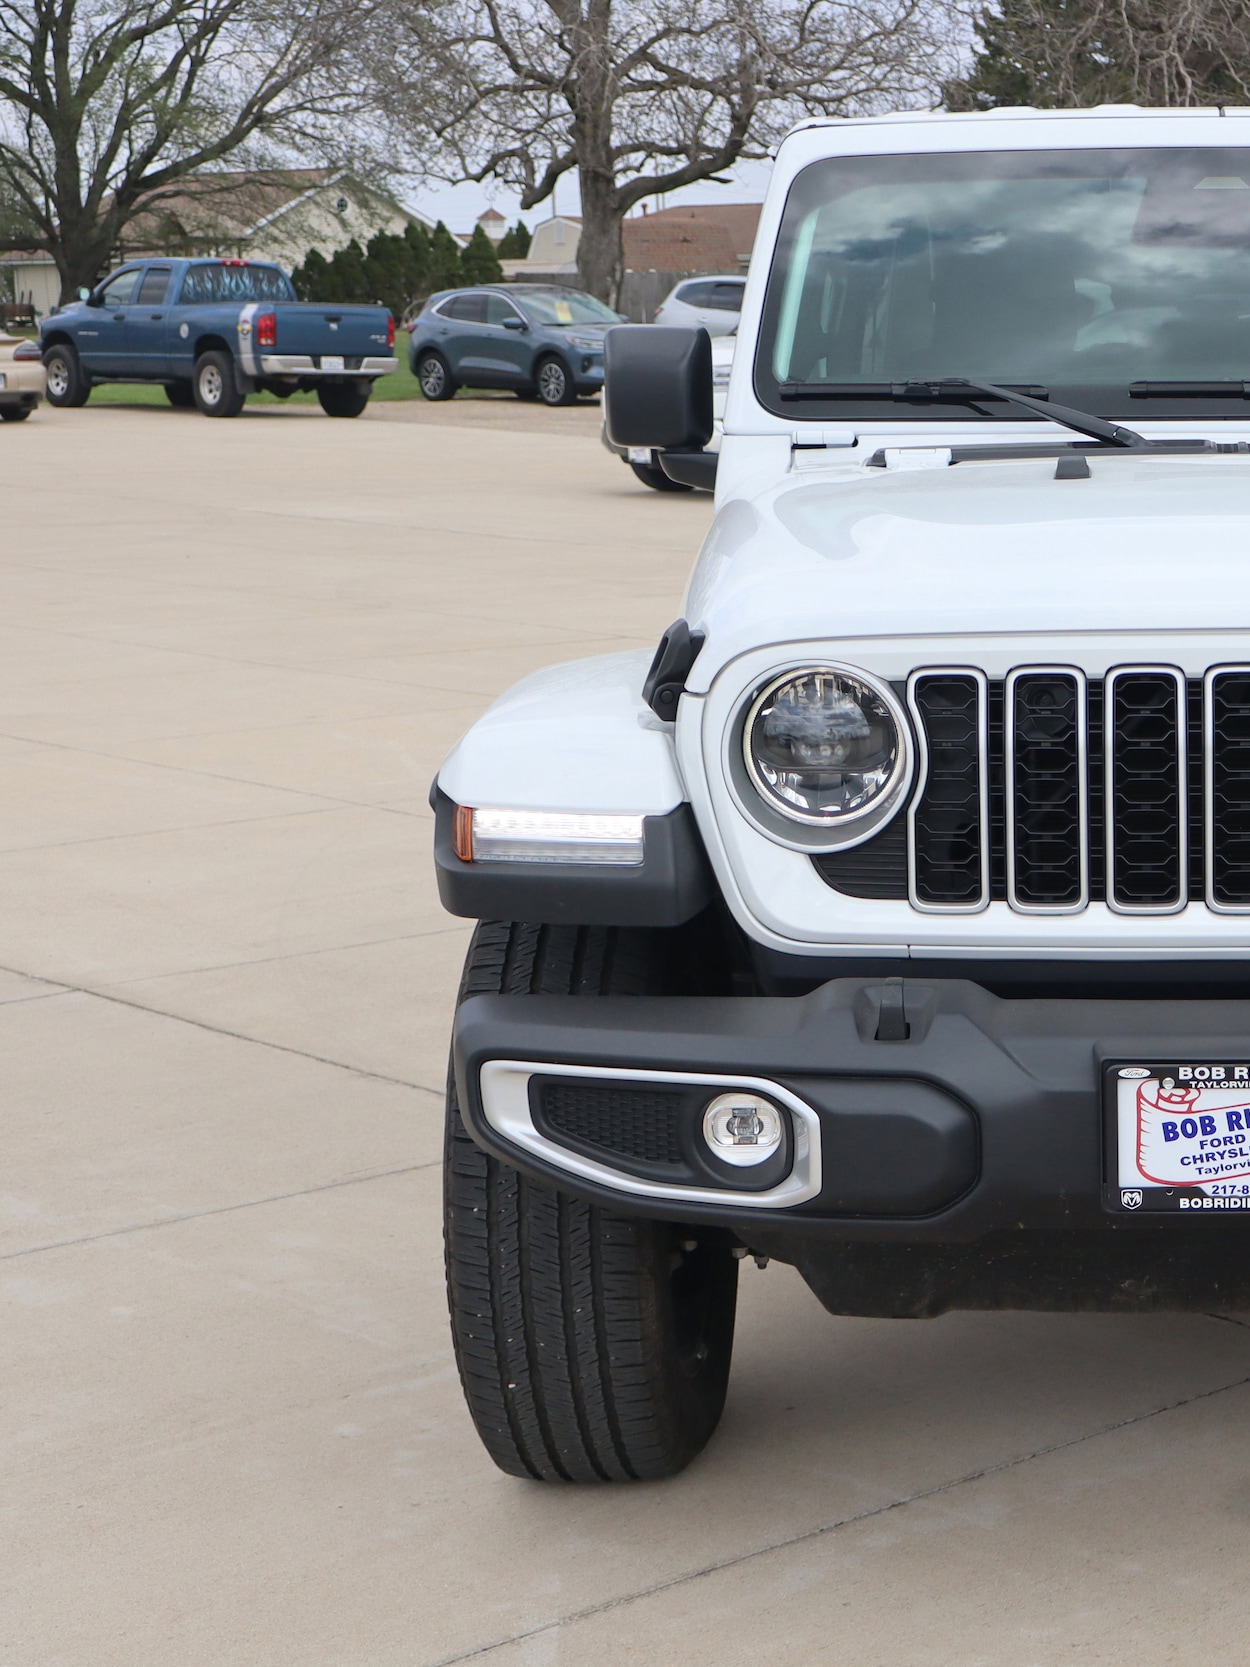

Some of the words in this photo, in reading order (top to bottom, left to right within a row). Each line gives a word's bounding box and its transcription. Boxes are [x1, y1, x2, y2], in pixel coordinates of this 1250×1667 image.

[1122, 1068, 1147, 1078] Ford
[1178, 1066, 1226, 1080] BOB
[1161, 1115, 1217, 1143] BOB
[1199, 1134, 1246, 1150] FORD
